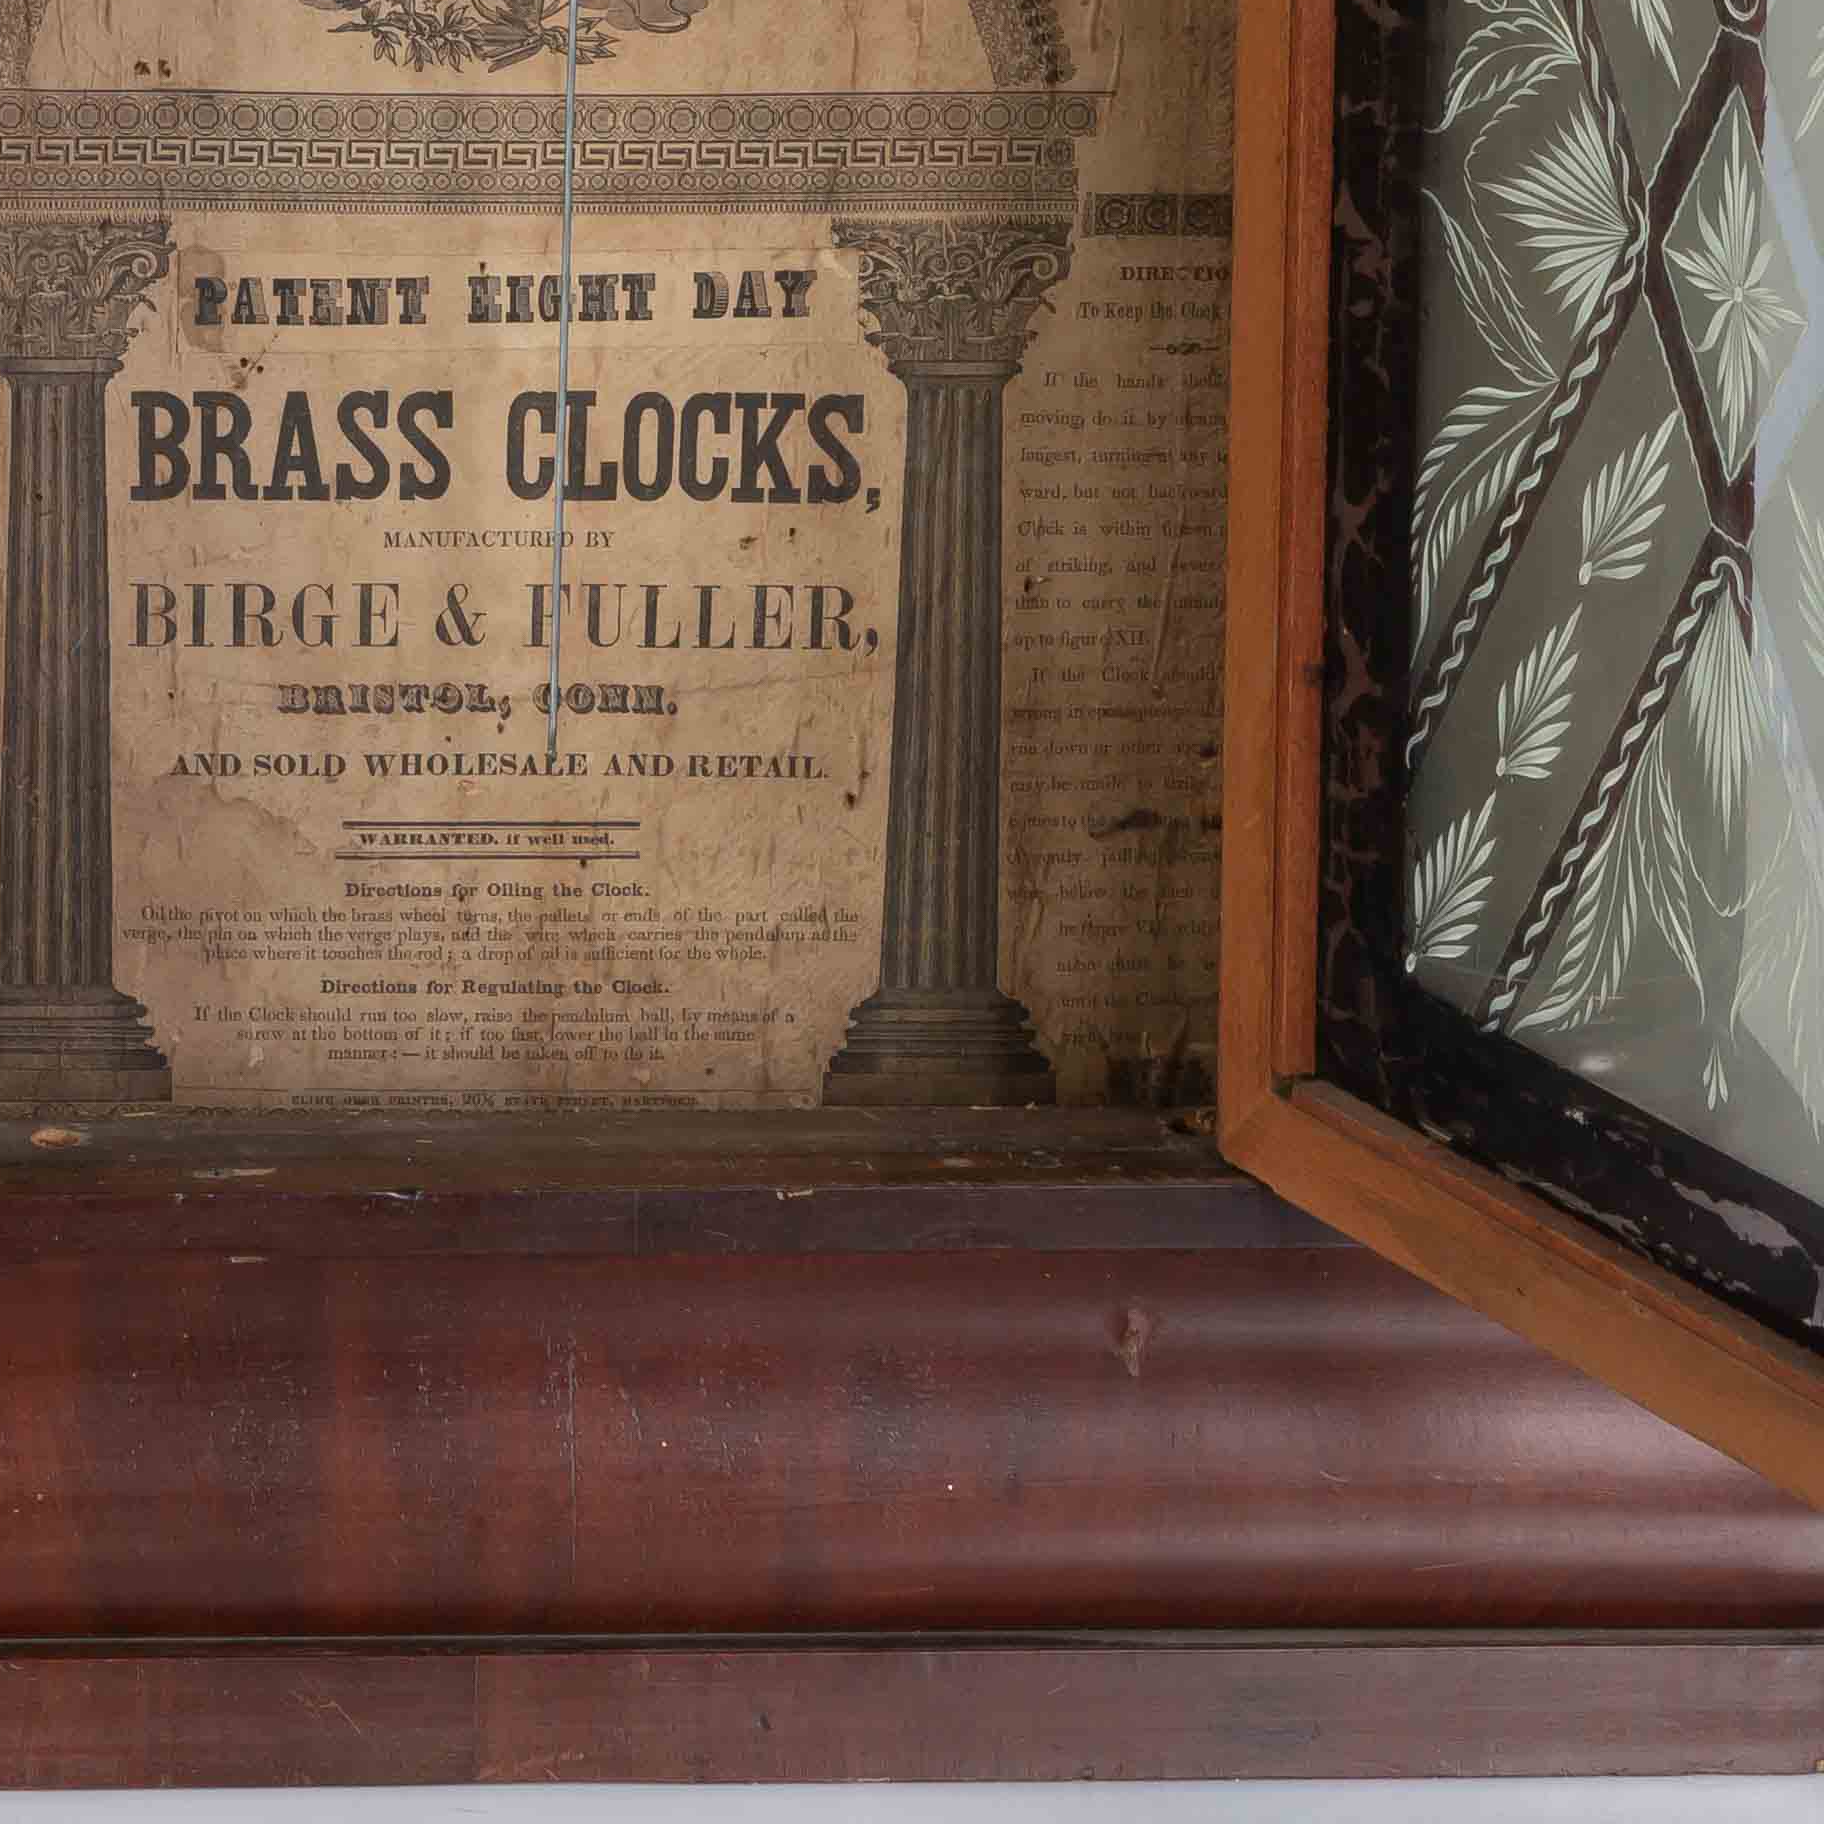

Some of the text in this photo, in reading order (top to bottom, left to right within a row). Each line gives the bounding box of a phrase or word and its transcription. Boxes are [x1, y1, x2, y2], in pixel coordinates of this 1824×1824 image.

[194, 270, 818, 326] PATENT EIGHT DAY
[128, 390, 882, 514] BRASS CLOCKS,
[383, 530, 615, 549] MANUFACTURED BY
[128, 584, 879, 658] BIRGE & FULLER,
[532, 683, 678, 716] CONN.
[170, 753, 241, 778] AND
[252, 752, 346, 778] SOLD
[364, 753, 588, 778] WHOLESALE
[602, 752, 674, 778] AND
[528, 832, 564, 845] well
[345, 883, 650, 900] Directions for Oiling the Clock.
[270, 906, 318, 922] which
[264, 926, 312, 942] which
[320, 979, 417, 994] Directions
[425, 979, 453, 994] for
[461, 979, 564, 998] Regulating
[573, 979, 602, 994] the
[248, 1007, 295, 1023] Clock
[343, 1027, 398, 1042] bottom
